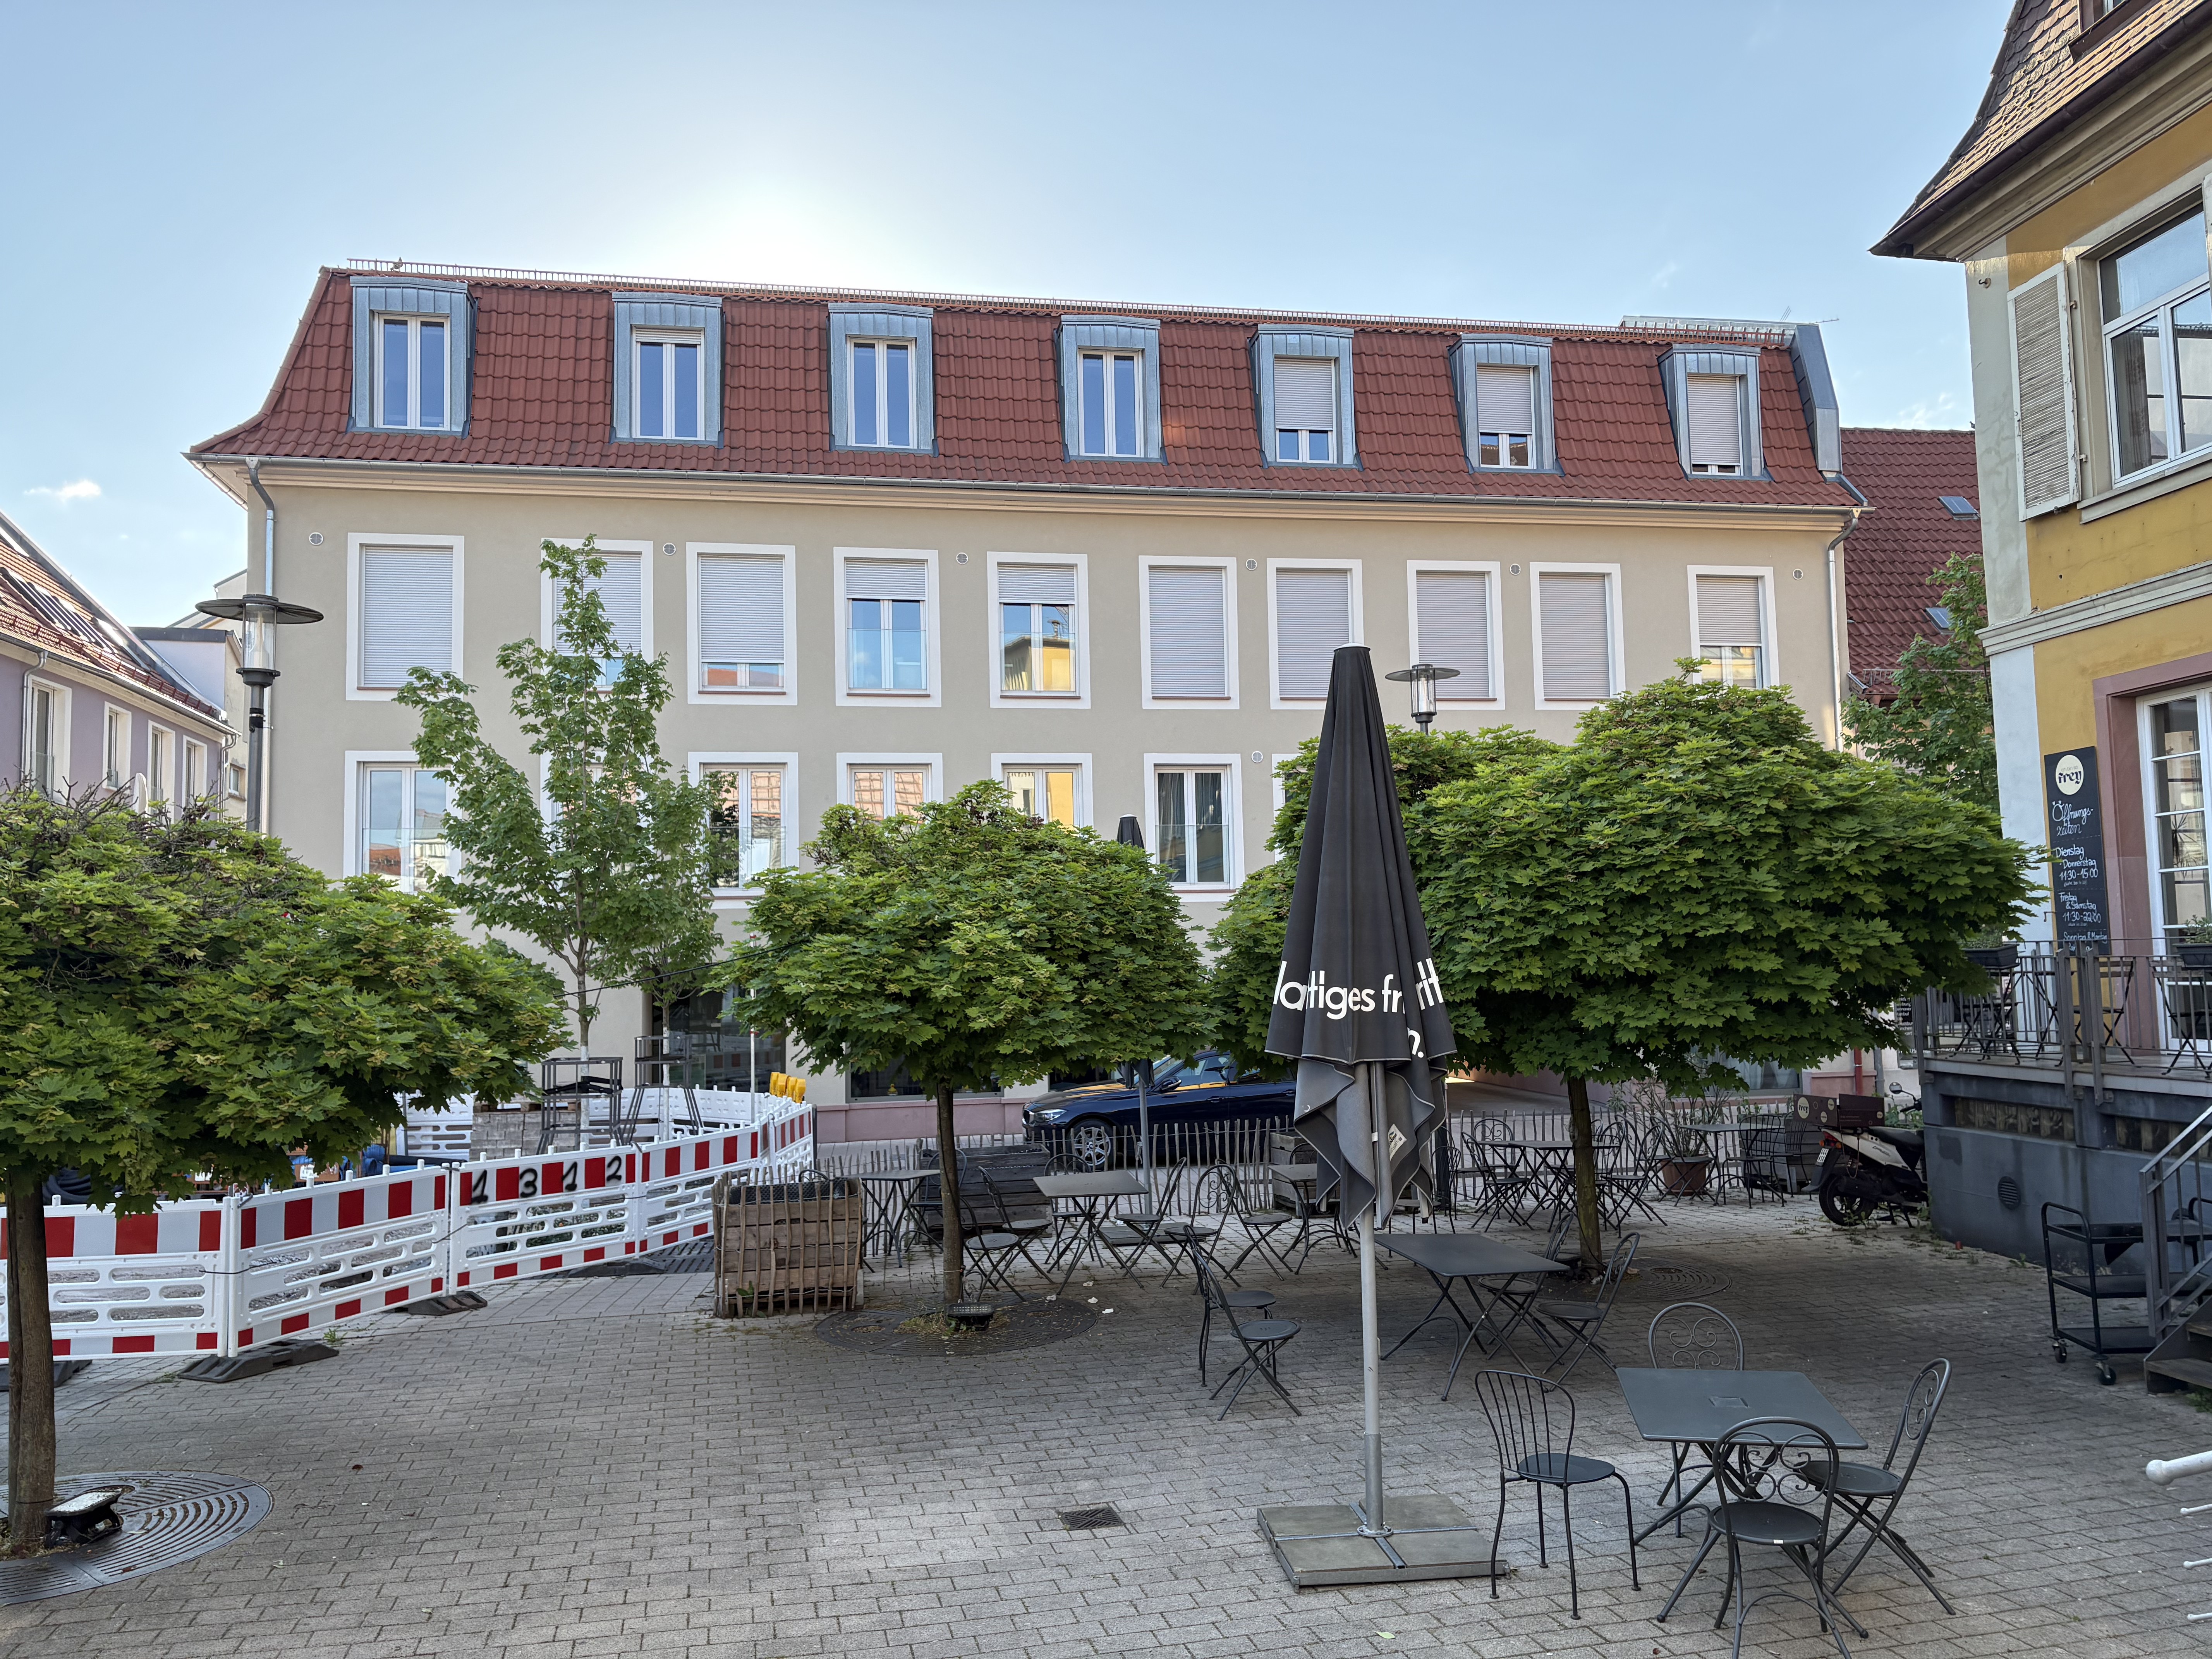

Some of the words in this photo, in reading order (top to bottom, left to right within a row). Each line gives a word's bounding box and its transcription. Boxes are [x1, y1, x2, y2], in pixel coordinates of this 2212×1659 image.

[2058, 771, 2081, 785] frey
[2055, 844, 2085, 860] Dienstag
[2058, 892, 2078, 904] Freitag
